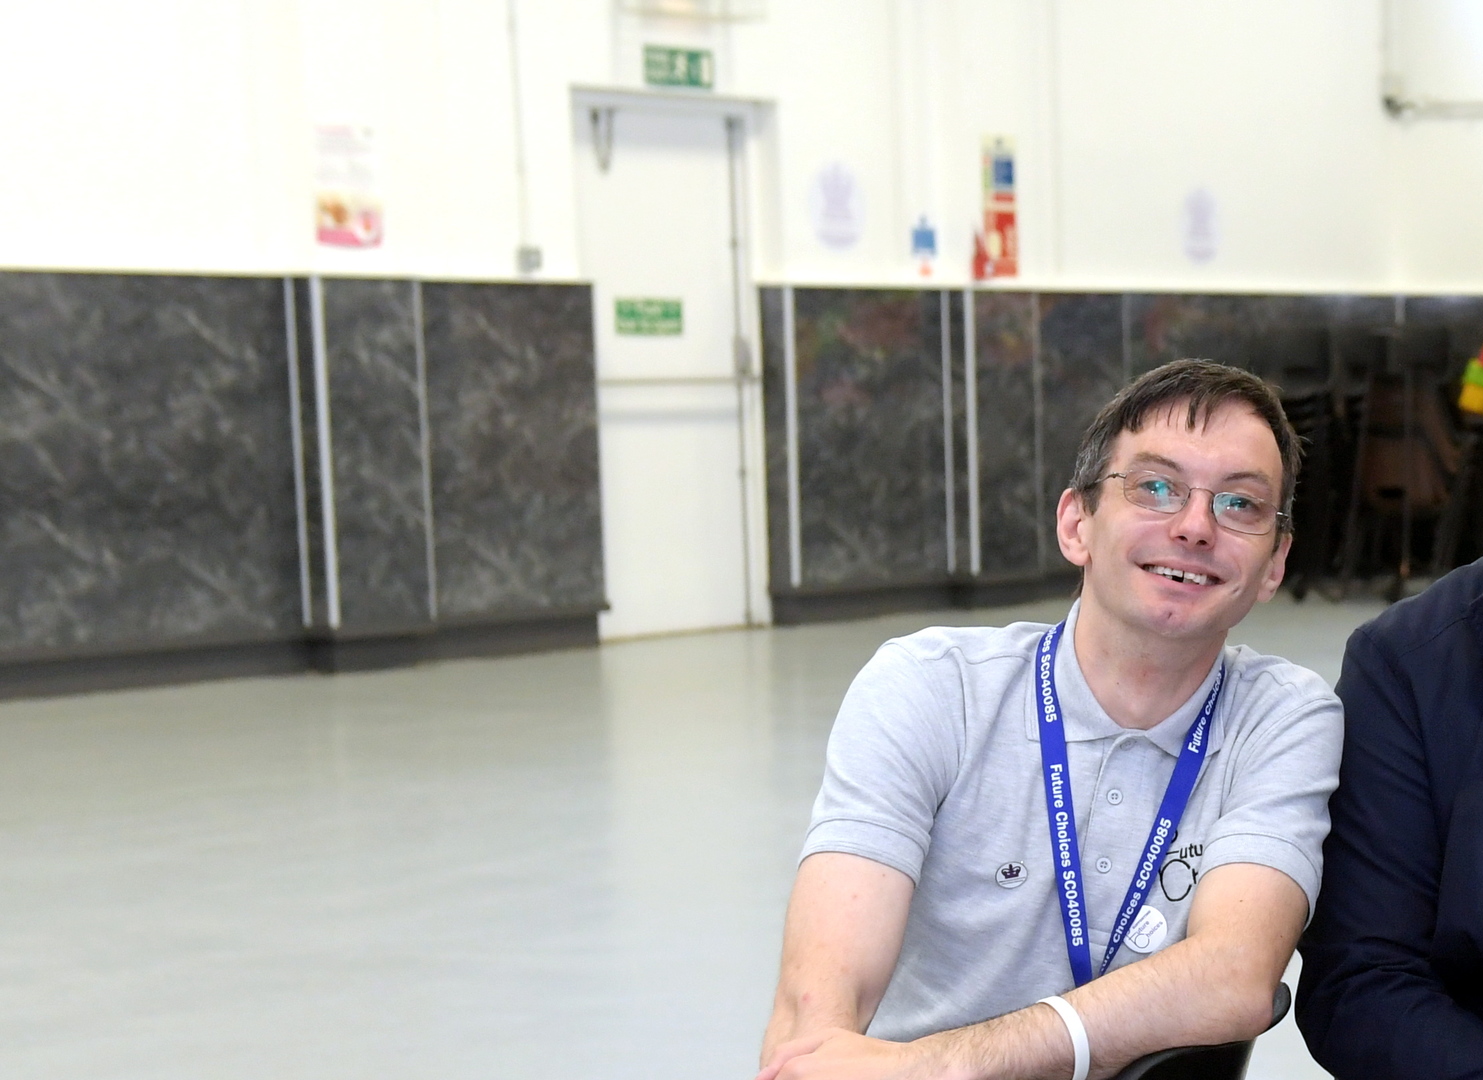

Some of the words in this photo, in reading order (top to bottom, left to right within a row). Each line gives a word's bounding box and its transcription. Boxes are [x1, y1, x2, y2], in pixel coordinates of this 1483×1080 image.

[1040, 654, 1058, 723] SC040085
[1187, 716, 1207, 754] Future
[1050, 763, 1064, 808] Future
[1055, 811, 1072, 867] Choices
[1062, 870, 1084, 947] SC040085
[1113, 891, 1141, 943] Choices
[1136, 817, 1172, 890] SC040085
